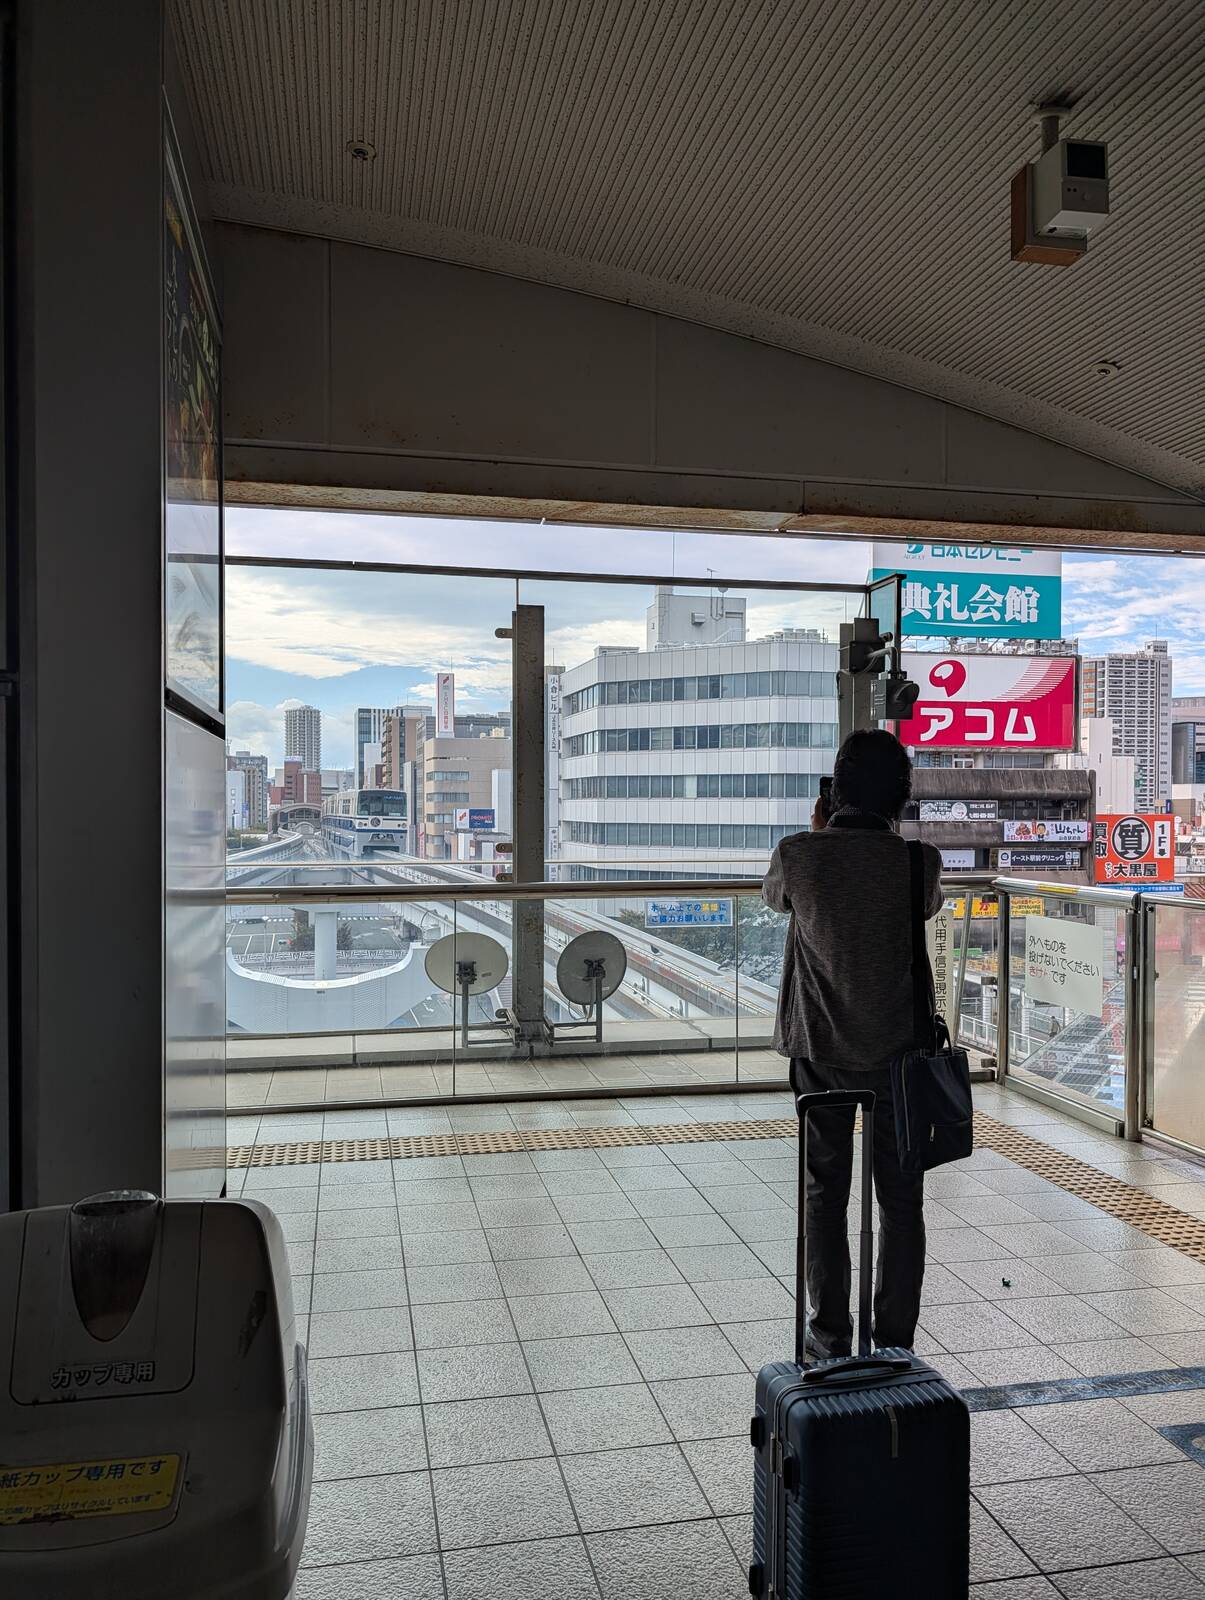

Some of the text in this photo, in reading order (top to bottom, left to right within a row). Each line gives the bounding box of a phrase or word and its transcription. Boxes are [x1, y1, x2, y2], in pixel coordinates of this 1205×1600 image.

[901, 582, 1040, 623] 典礼会館
[550, 677, 558, 711] 小倉ビル
[920, 707, 1037, 742] アコム
[1055, 823, 1086, 835] 山ちゃん
[1119, 823, 1146, 857] 質
[1158, 824, 1167, 847] 1F
[1114, 863, 1157, 876] 大黒屋
[1029, 935, 1067, 954] 外へものを
[1029, 951, 1100, 976] 投げないでください
[52, 1361, 155, 1389] カップ専用
[0, 1460, 167, 1489] 紙カップ専用です
